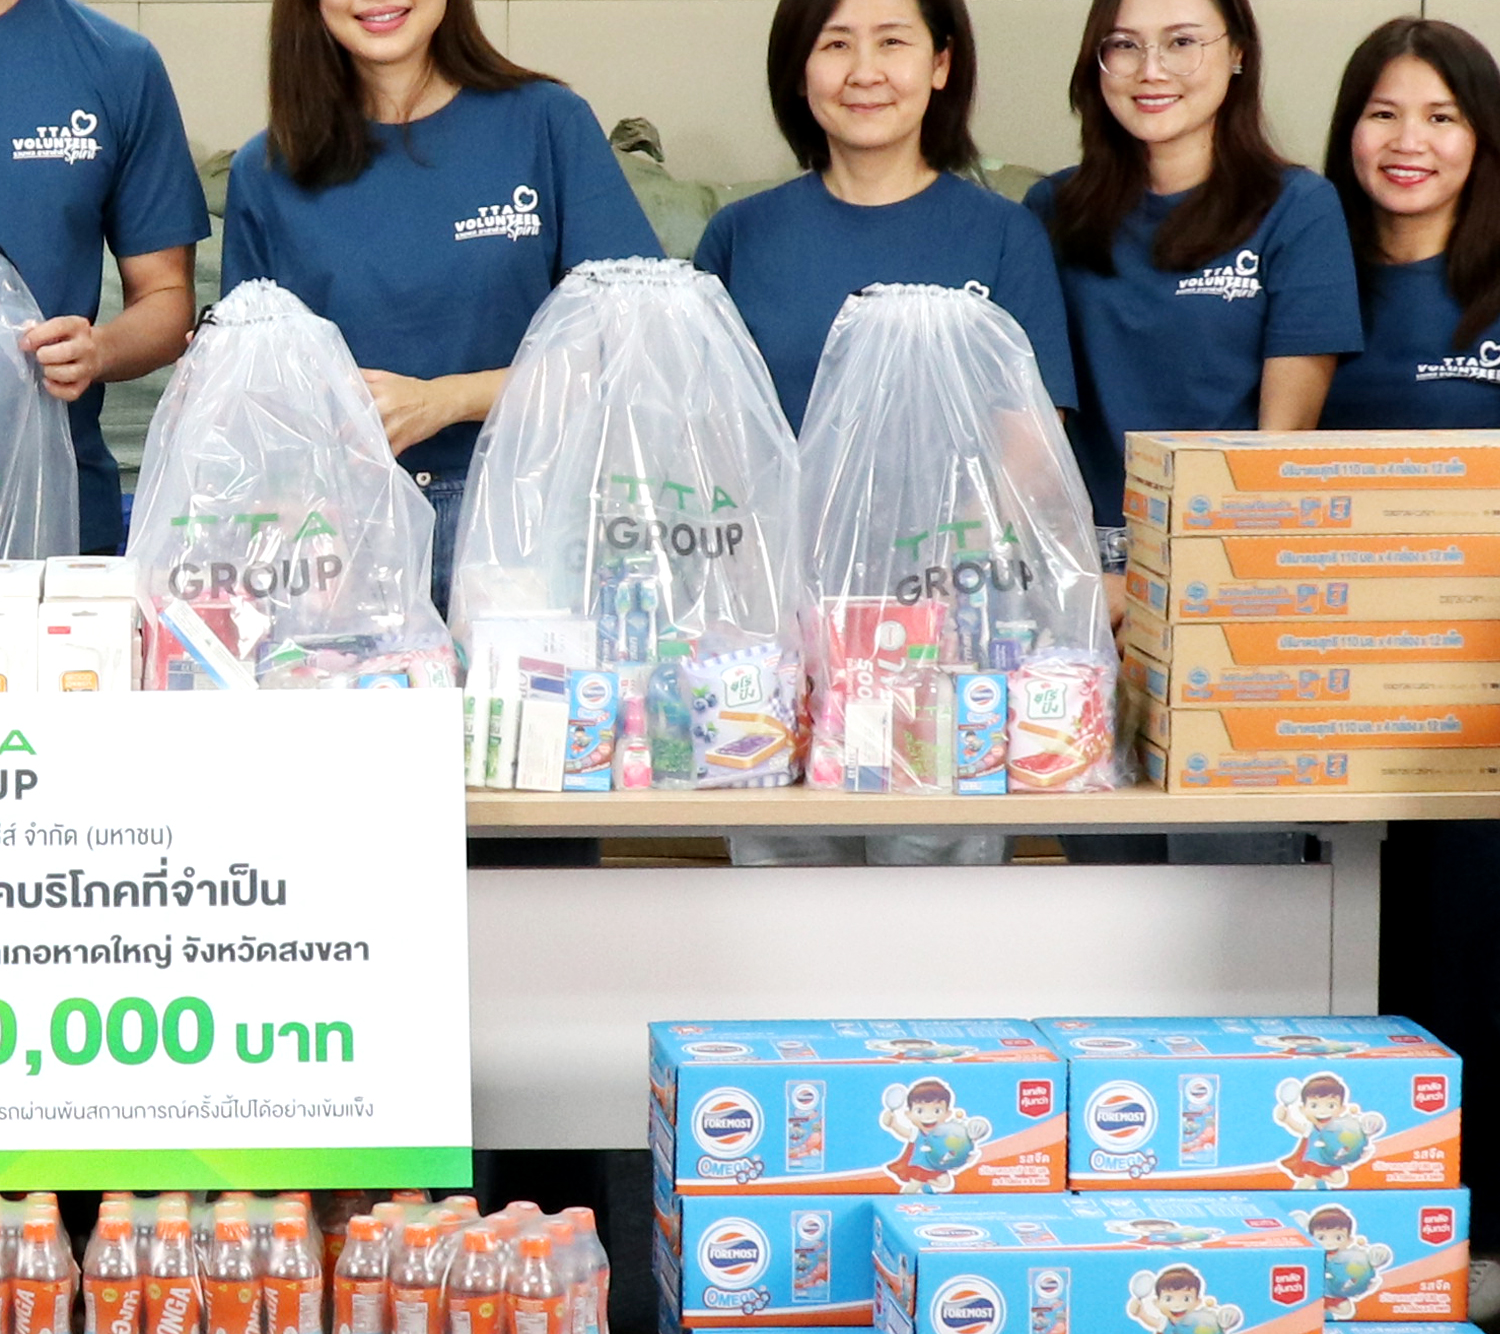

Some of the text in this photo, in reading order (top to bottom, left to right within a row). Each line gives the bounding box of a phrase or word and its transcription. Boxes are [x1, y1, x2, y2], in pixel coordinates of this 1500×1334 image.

[37, 127, 71, 138] TTA
[12, 137, 97, 151] VOLUNTEER
[478, 205, 513, 217] TTA
[454, 213, 540, 233] VOLUNTEER
[1203, 265, 1234, 278] TTA
[1443, 356, 1478, 367] TTA
[609, 475, 738, 513] TTA
[605, 514, 744, 559] GROUP
[167, 553, 343, 602] GROUP
[24, 822, 78, 847] จำกัด
[87, 824, 173, 851] (มหาชน)
[182, 935, 370, 963] จังหวัดสงขลา
[235, 1016, 355, 1063] บาท
[703, 1117, 754, 1131] FOREMOST
[1095, 1112, 1146, 1126] FOREMOST
[943, 1307, 994, 1322] FOREMOST
